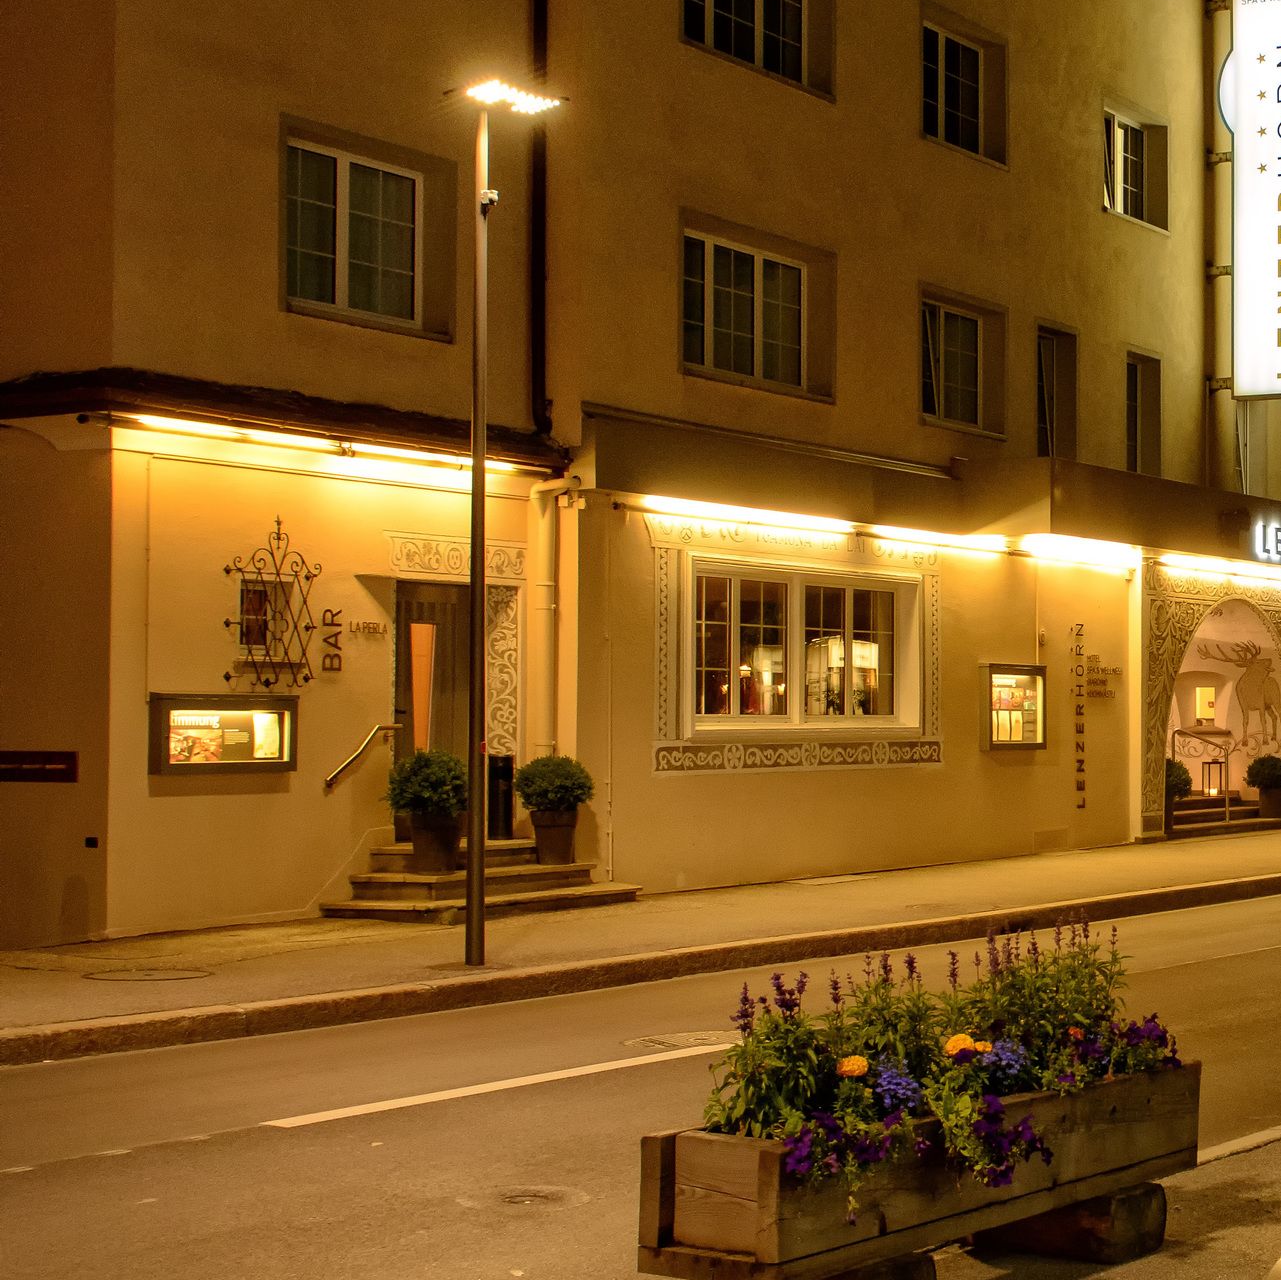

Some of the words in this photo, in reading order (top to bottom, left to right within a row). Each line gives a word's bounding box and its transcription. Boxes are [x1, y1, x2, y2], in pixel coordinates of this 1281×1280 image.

[322, 609, 342, 671] BAR
[349, 621, 361, 632] LA
[362, 622, 388, 635] PERLA
[1075, 623, 1086, 809] LENZERHORN
